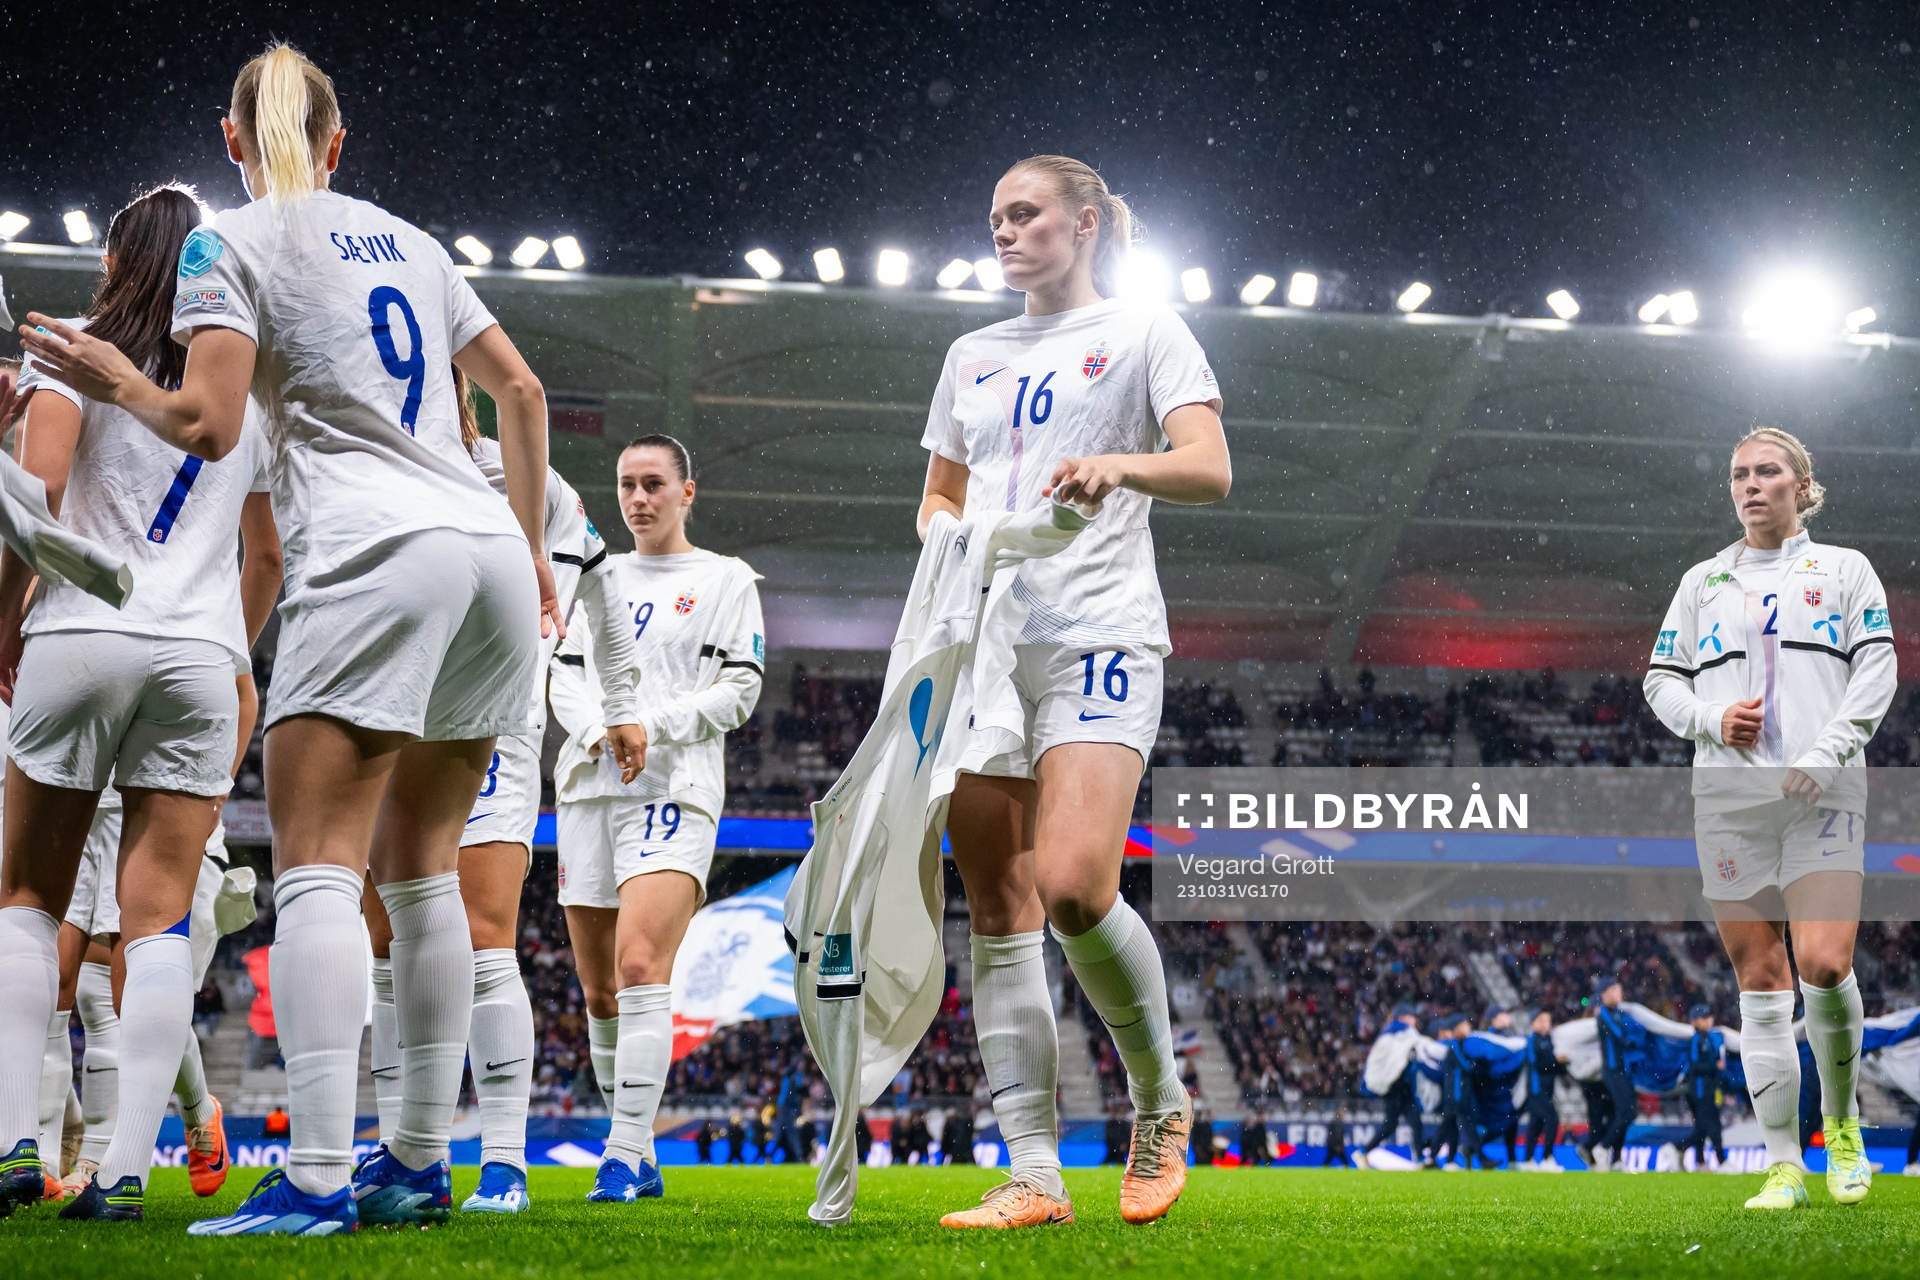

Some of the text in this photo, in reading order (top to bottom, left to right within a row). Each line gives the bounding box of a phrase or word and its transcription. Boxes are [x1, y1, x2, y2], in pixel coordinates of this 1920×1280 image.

[330, 232, 407, 263] SÆVIK
[368, 285, 425, 437] 9
[1012, 371, 1057, 428] 16
[628, 601, 654, 641] 9
[1080, 652, 1129, 702] 16
[644, 802, 681, 840] 19
